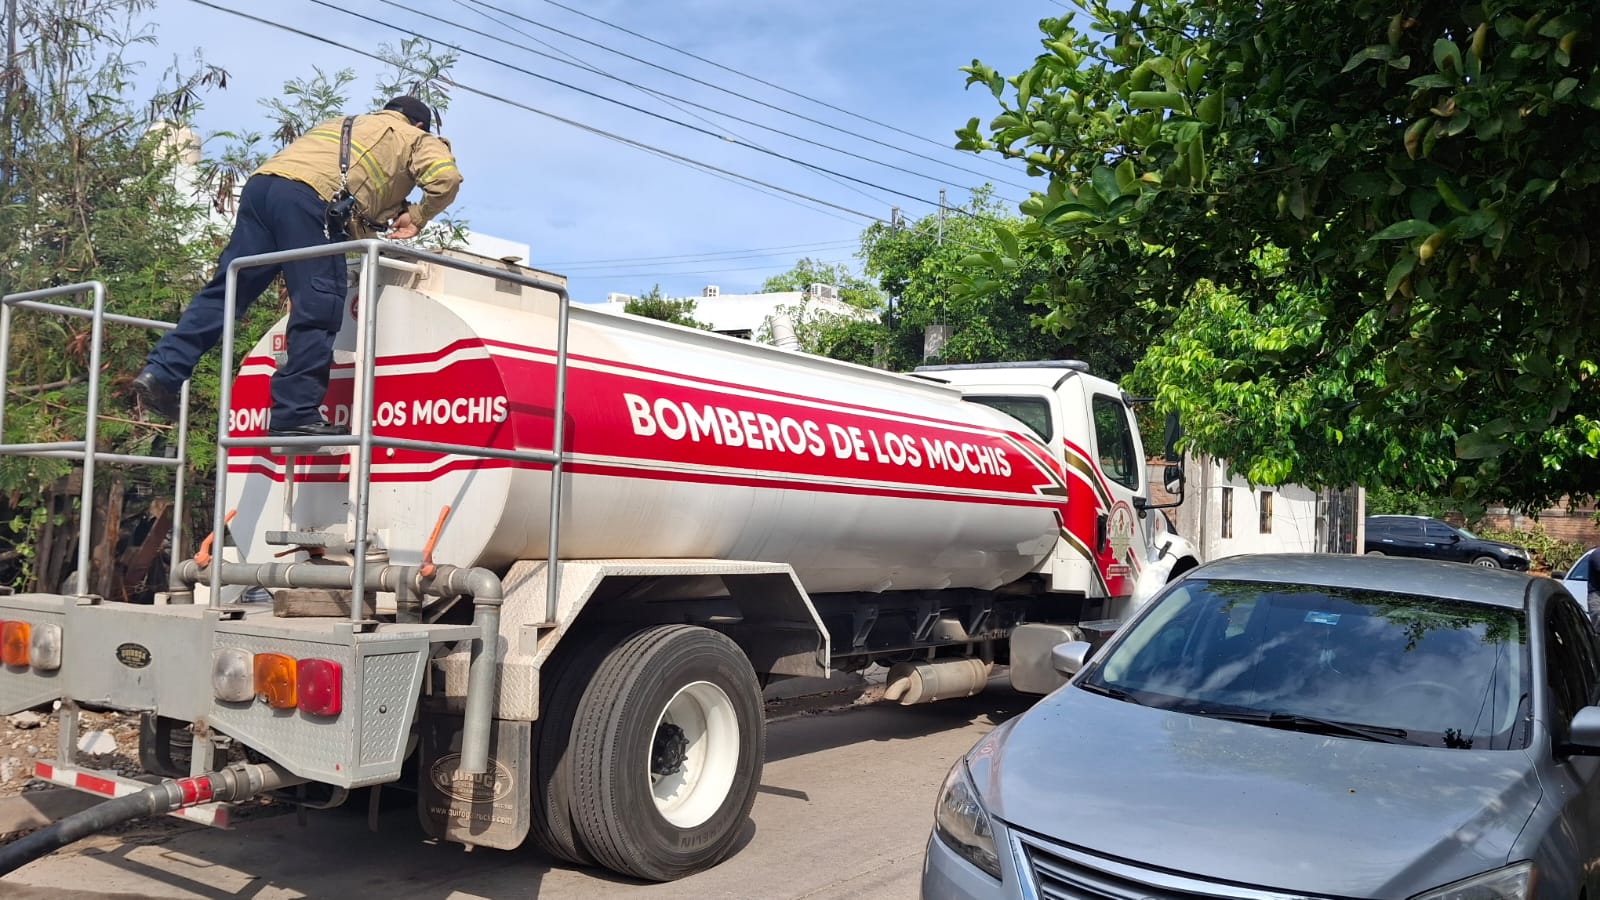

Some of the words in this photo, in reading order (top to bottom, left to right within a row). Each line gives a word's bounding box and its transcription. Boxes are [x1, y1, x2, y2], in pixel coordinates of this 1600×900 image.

[335, 404, 354, 427] D
[372, 401, 407, 427] OS
[412, 396, 508, 425] MOCHIS
[623, 393, 825, 457] BOMBEROS
[827, 423, 870, 461] DE
[869, 430, 922, 467] LOS
[920, 437, 1012, 477] MOCHIS
